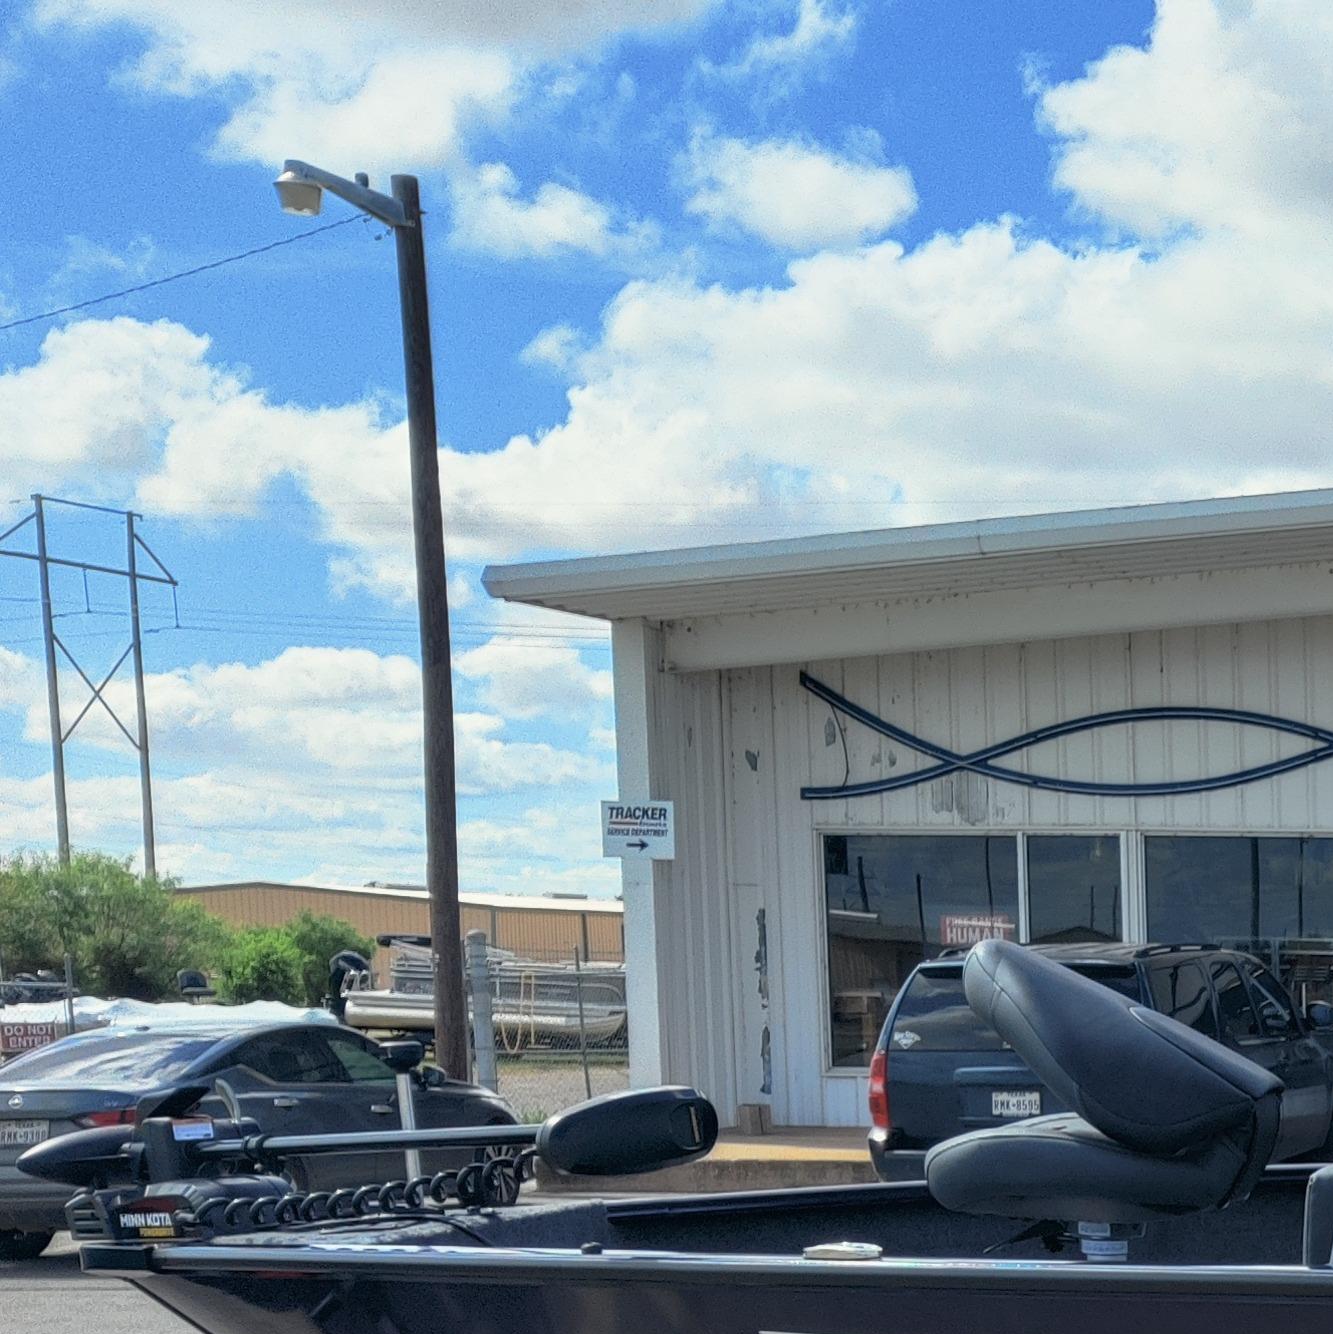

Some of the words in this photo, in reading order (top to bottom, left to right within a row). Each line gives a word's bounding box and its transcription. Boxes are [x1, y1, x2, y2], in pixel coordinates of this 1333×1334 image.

[607, 806, 667, 820] TRACKER
[631, 828, 668, 837] DEPARTMENT
[946, 927, 1004, 944] HUMAN
[4, 1024, 24, 1036] DO
[27, 1024, 52, 1035] NOT
[119, 1213, 145, 1228] MINN
[146, 1212, 172, 1227] KOTA
